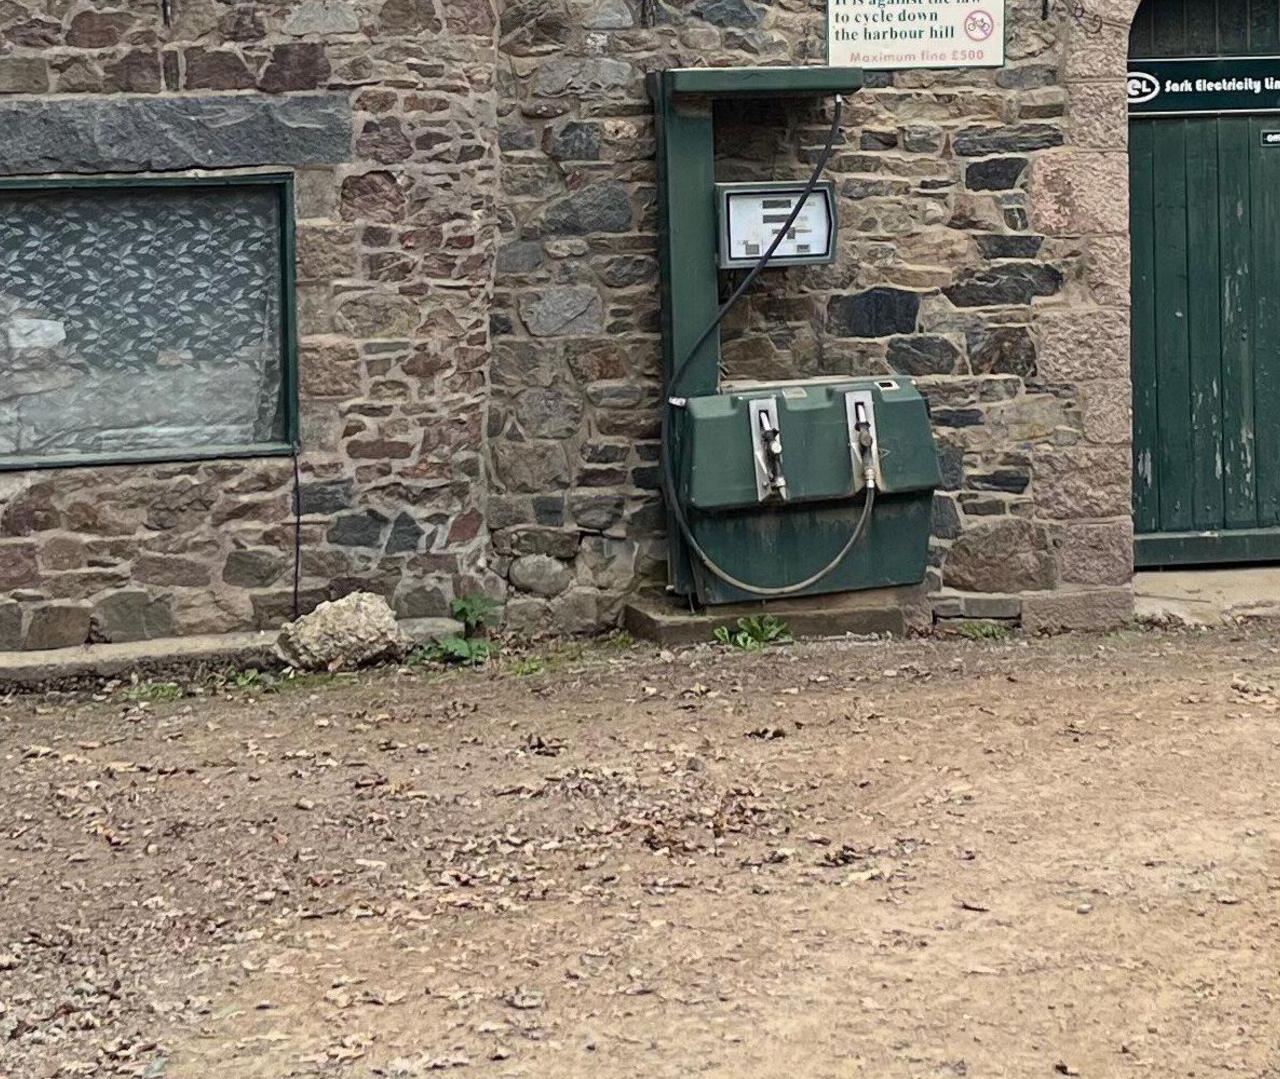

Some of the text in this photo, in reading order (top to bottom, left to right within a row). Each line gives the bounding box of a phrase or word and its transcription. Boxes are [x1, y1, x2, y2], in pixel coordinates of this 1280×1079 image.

[835, 9, 938, 26] to cycle down
[835, 25, 955, 41] the harbour hill
[849, 49, 984, 63] Maximum fine £500
[1127, 79, 1152, 96] eL
[1165, 79, 1193, 93] Sark
[1195, 77, 1261, 94] Electricity
